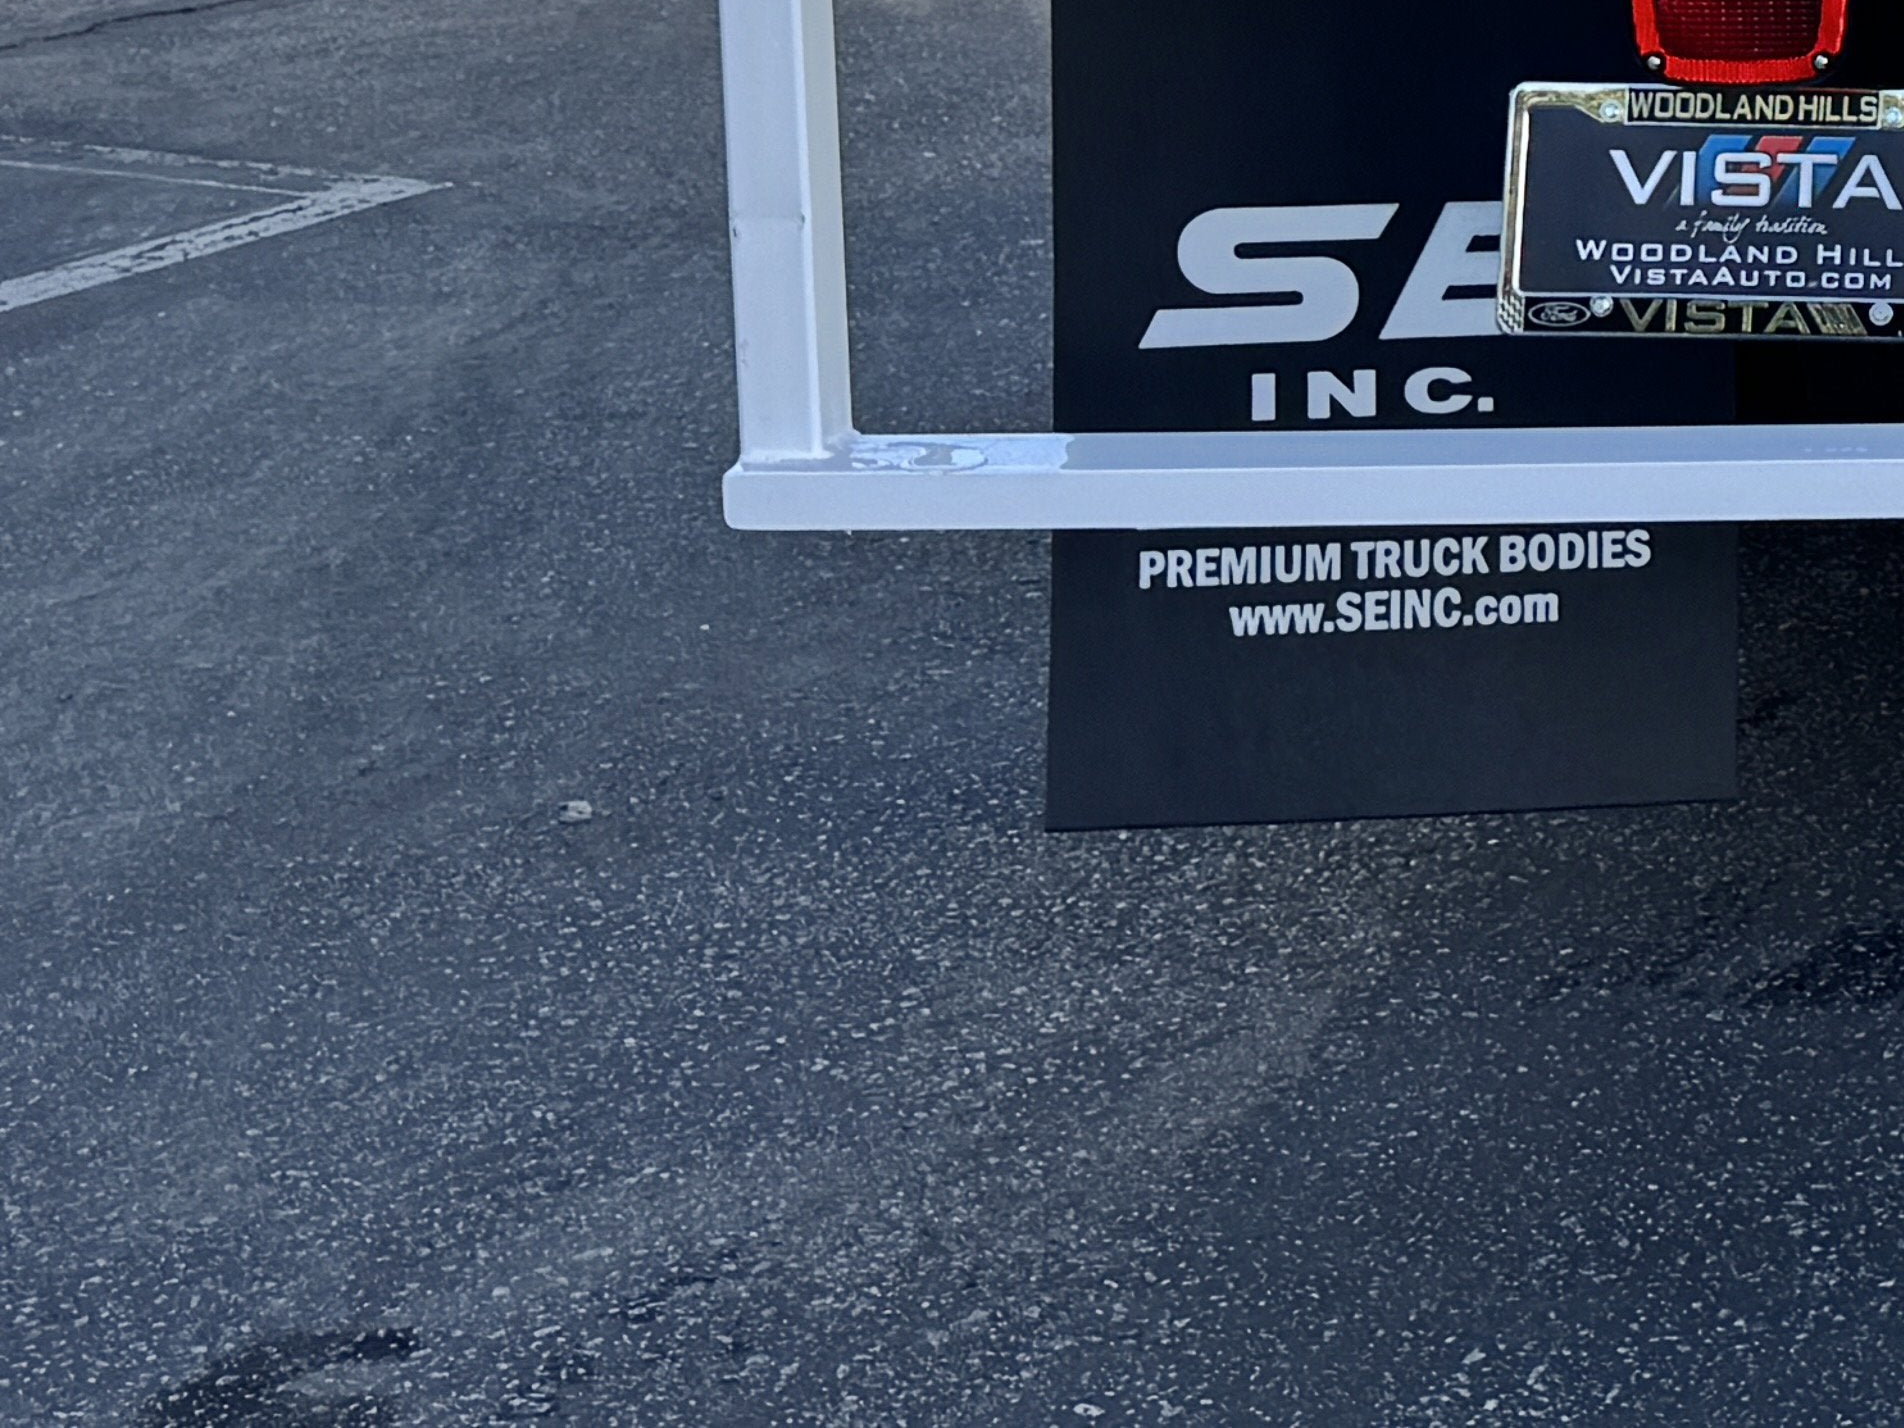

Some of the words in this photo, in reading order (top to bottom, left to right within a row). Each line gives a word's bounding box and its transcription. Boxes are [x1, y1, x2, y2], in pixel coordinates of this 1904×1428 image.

[1630, 90, 1795, 123] WOODLAND
[1798, 94, 1879, 124] HILLS
[1609, 148, 1903, 210] VISTA
[1690, 209, 1751, 244] family
[1575, 238, 1799, 265] WOODLAND
[1619, 298, 1811, 334] VISTA
[1250, 366, 1495, 422] INC.
[1138, 542, 1342, 589] PREMIUM
[1350, 536, 1490, 581] TRUCK
[1499, 529, 1652, 572] BODIES
[1229, 590, 1560, 637] www.SEINC.com
